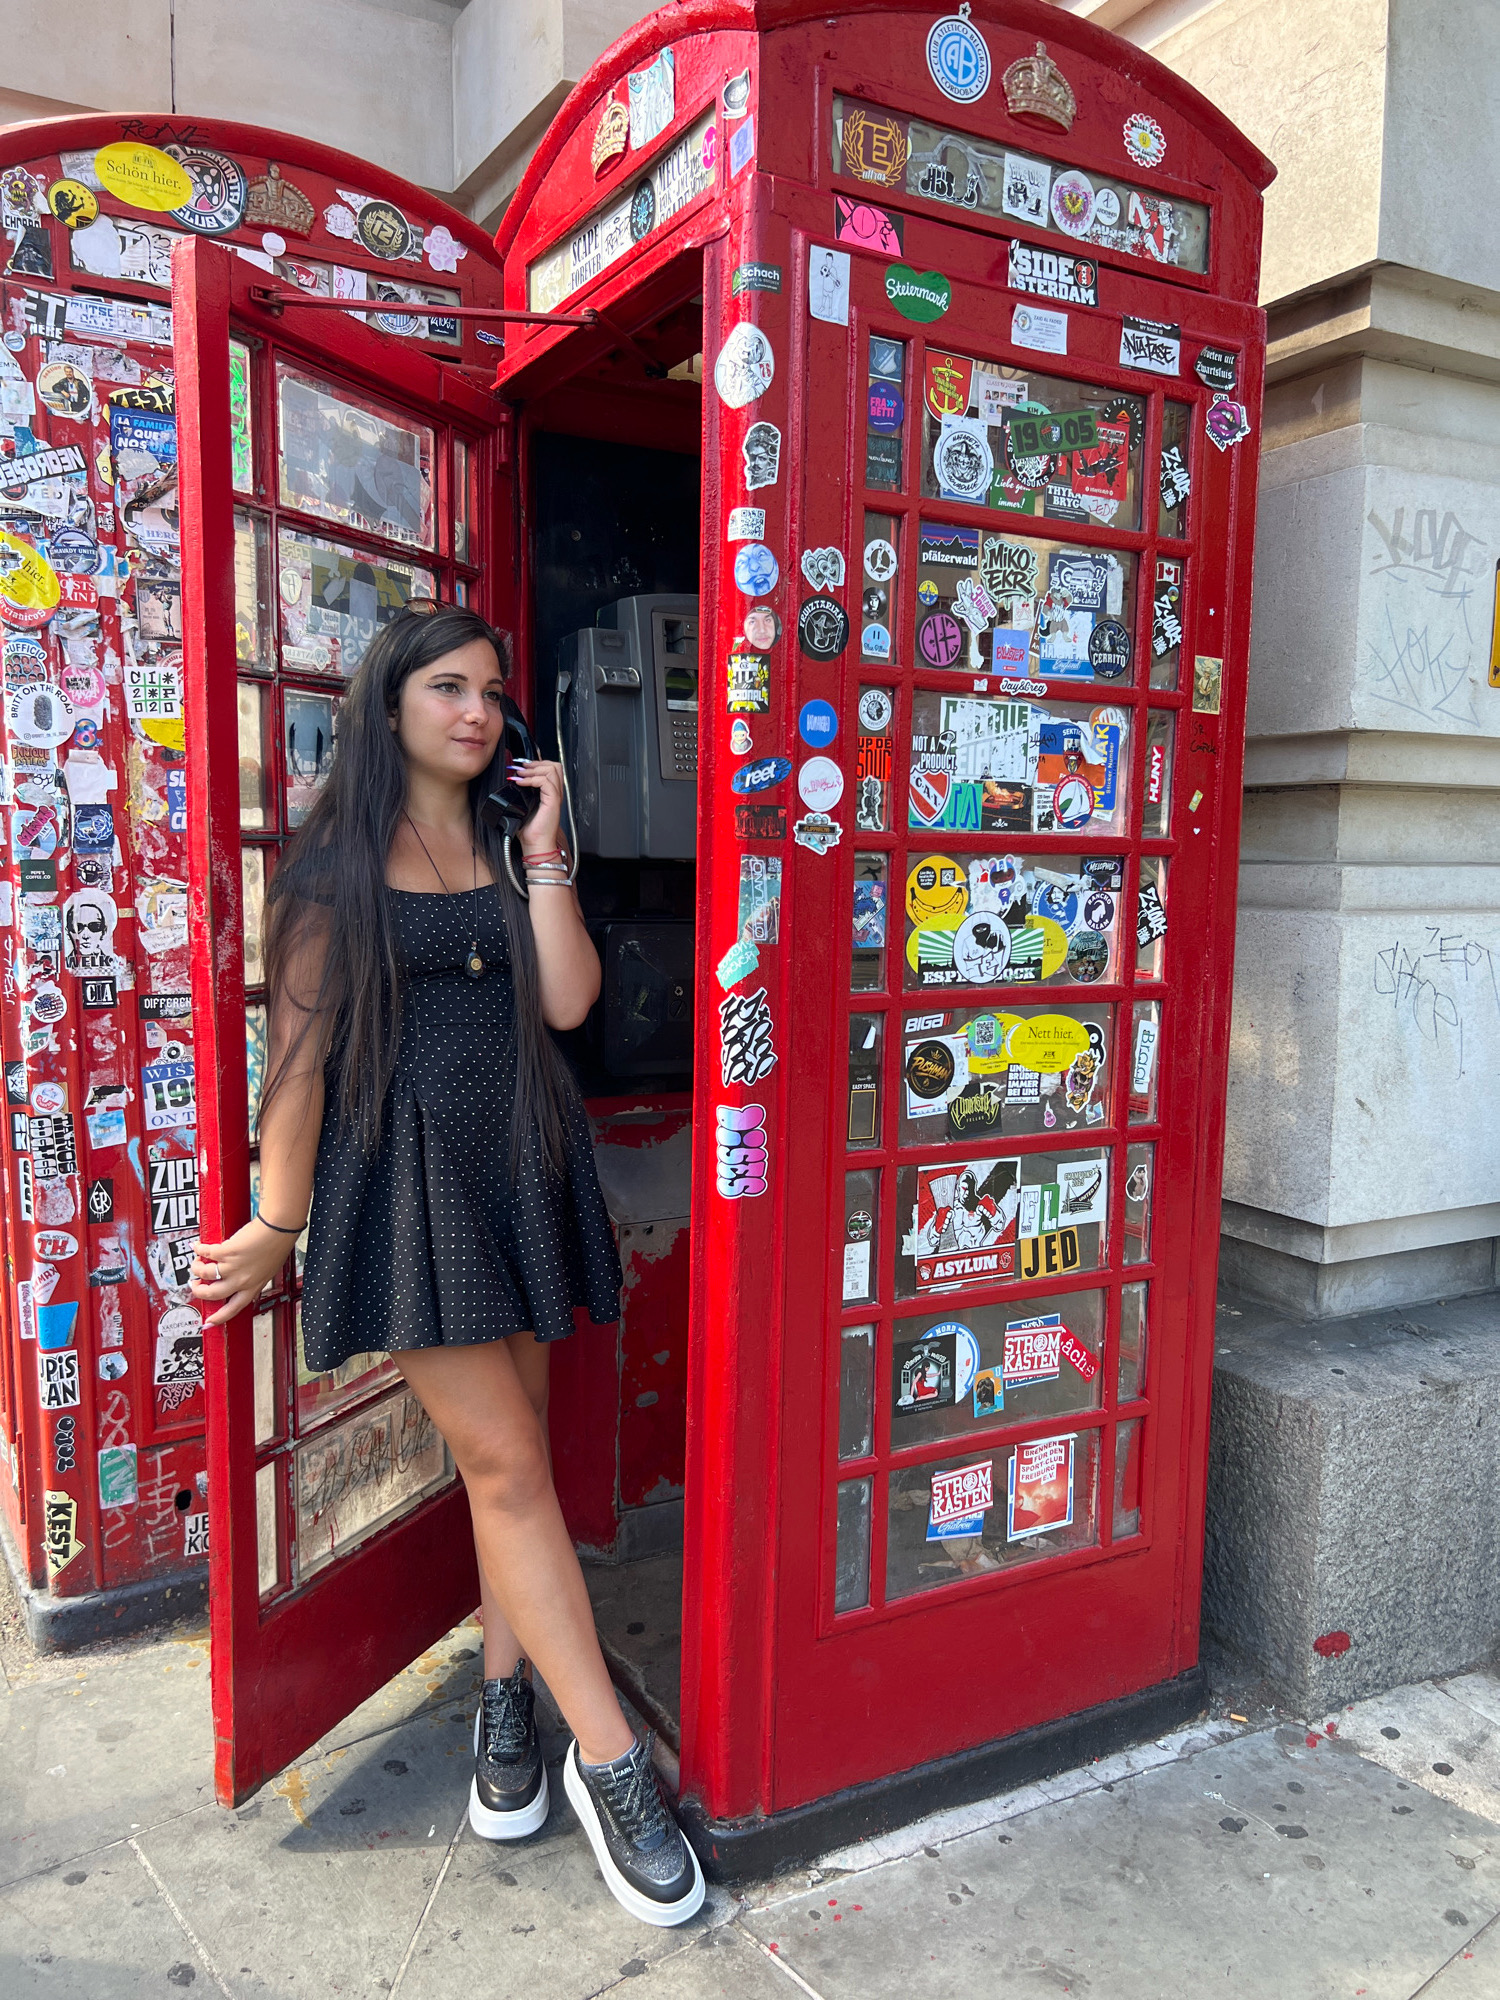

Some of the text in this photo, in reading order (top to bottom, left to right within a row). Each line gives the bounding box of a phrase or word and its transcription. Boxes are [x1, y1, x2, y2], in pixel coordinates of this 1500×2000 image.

[937, 24, 968, 39] ATLETICO
[969, 34, 985, 84] BELGRANO
[941, 76, 975, 96] CORDOBA
[106, 159, 182, 190] Schön hier.
[175, 206, 219, 228] CLUB
[742, 267, 780, 281] Schach
[885, 278, 949, 312] Steiermark
[870, 396, 887, 407] FRA
[1213, 393, 1229, 402] GOLD
[870, 406, 895, 418] BETTI
[117, 417, 174, 432] LA FAMILIA
[1206, 424, 1226, 449] DIGGER
[994, 474, 1015, 489] Liebe
[1017, 475, 1050, 488] CASUALS
[997, 498, 1025, 509] immer!
[922, 550, 978, 567] pfälzerwald
[1093, 652, 1126, 667] CERRITO
[10, 683, 74, 719] BRITT ON THE ROAD
[912, 735, 929, 752] NOT
[920, 754, 958, 771] PRODUCT.
[1148, 746, 1164, 803] HUNY
[1088, 891, 1111, 905] RANCHO
[1087, 918, 1110, 930] BALAM
[1028, 1026, 1074, 1040] Nett hier.
[1008, 1080, 1039, 1088] IMMER
[151, 1112, 178, 1127] ON
[1024, 1229, 1078, 1278] JED
[933, 1253, 998, 1279] ASYLUM
[936, 1325, 957, 1336] NORD
[1004, 1350, 1060, 1373] KASTEN
[1025, 1440, 1058, 1457] BRENNEN
[1049, 1448, 1063, 1456] DEN
[1021, 1455, 1063, 1473] SPORT-CLUB
[1021, 1464, 1056, 1481] FREIBURG
[932, 1485, 992, 1519] KASTEN
